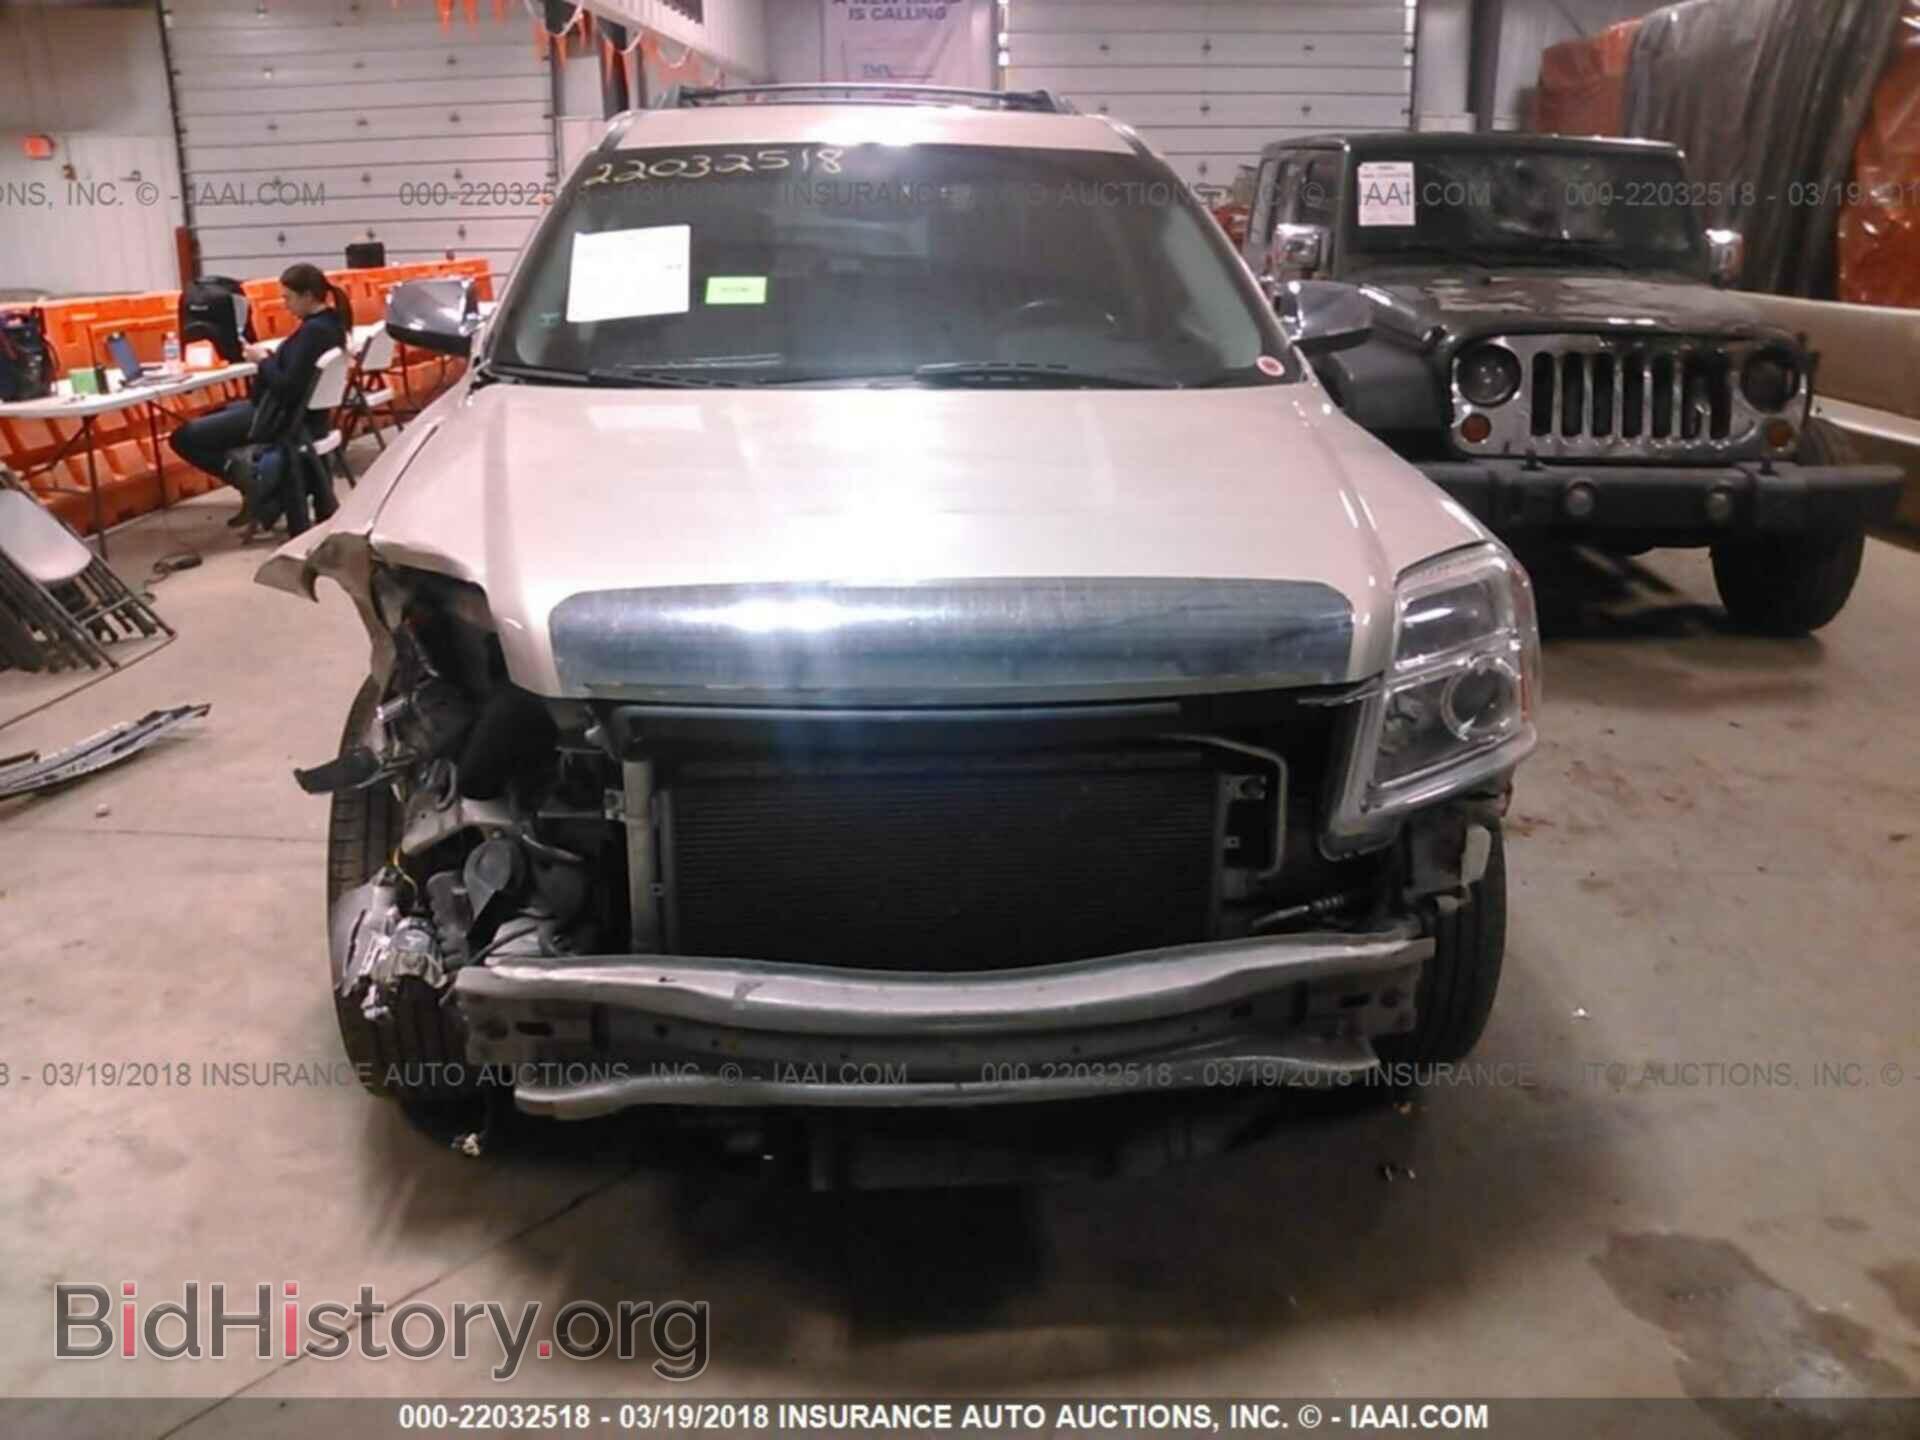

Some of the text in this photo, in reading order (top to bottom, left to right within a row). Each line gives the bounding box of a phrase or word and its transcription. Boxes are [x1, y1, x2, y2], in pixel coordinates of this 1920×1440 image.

[848, 6, 947, 20] IS CALLING
[583, 149, 843, 186] 22032518
